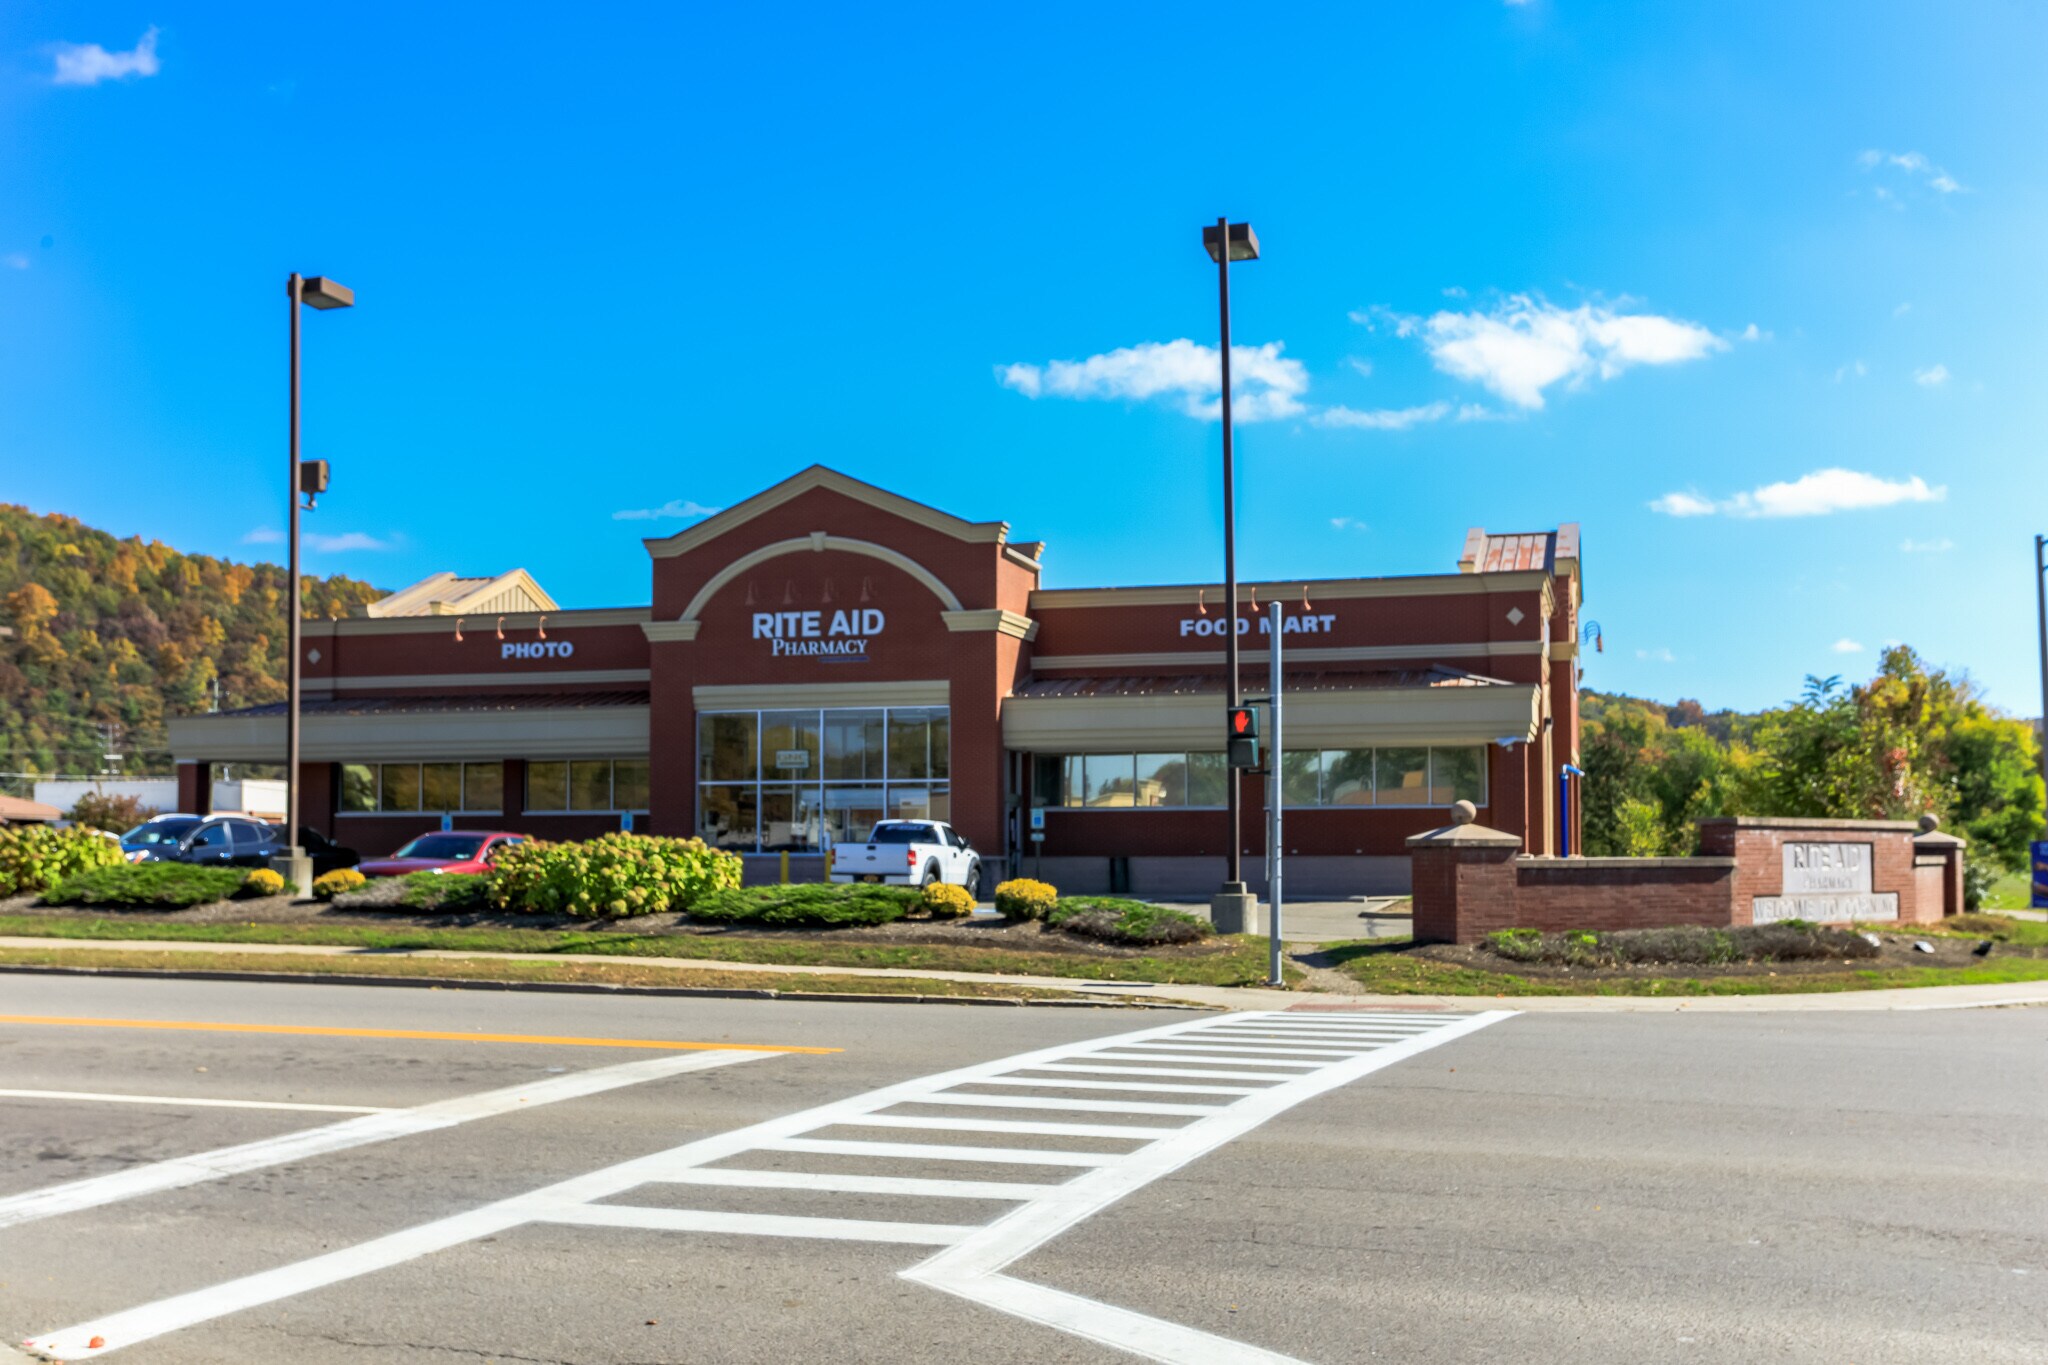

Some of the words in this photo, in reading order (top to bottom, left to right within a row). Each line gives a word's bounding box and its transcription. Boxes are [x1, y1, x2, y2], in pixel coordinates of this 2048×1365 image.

[752, 611, 822, 639] RITE
[828, 608, 886, 636] AID
[501, 641, 574, 659] PHOTO
